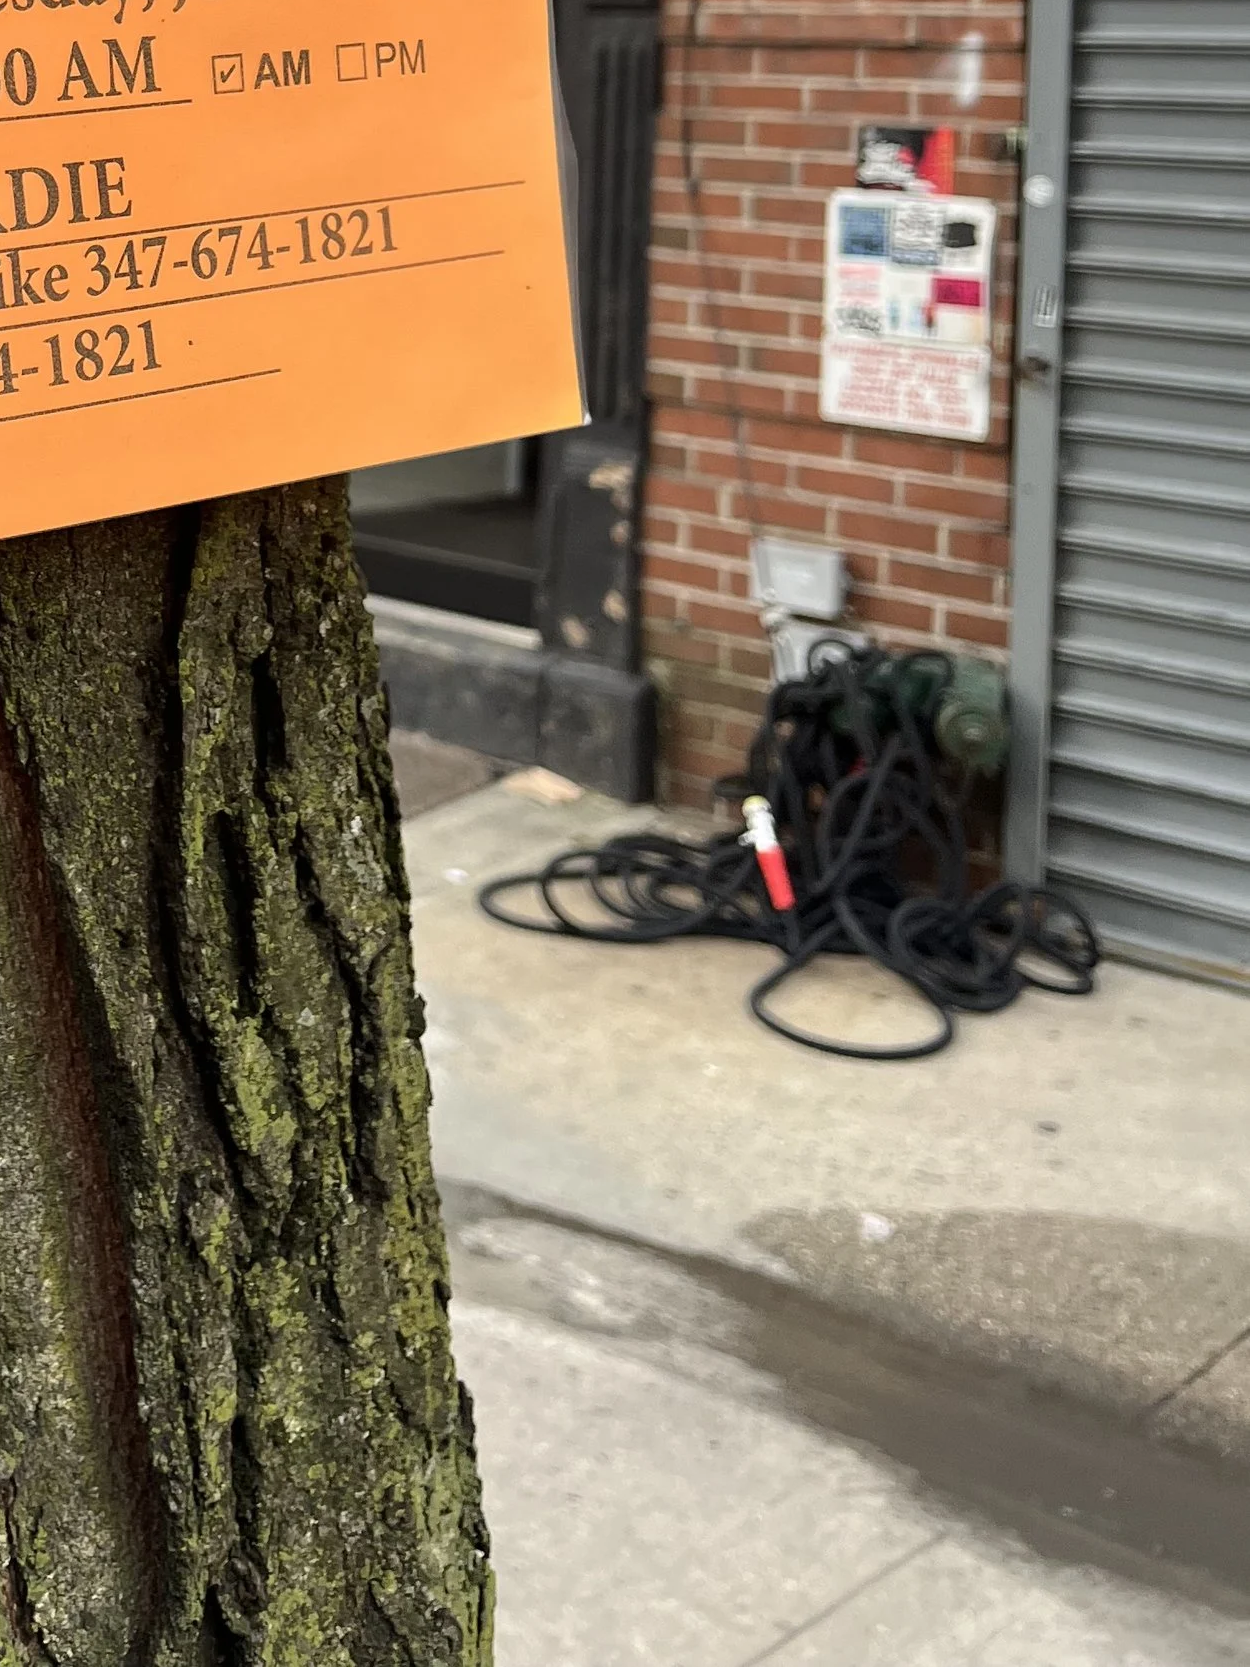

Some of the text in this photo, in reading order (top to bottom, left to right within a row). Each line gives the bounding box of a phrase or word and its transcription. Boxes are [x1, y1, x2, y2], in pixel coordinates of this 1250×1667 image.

[56, 35, 163, 102] AM
[253, 48, 312, 90] AM
[375, 38, 426, 78] PM
[84, 205, 398, 297] 347-674-1821
